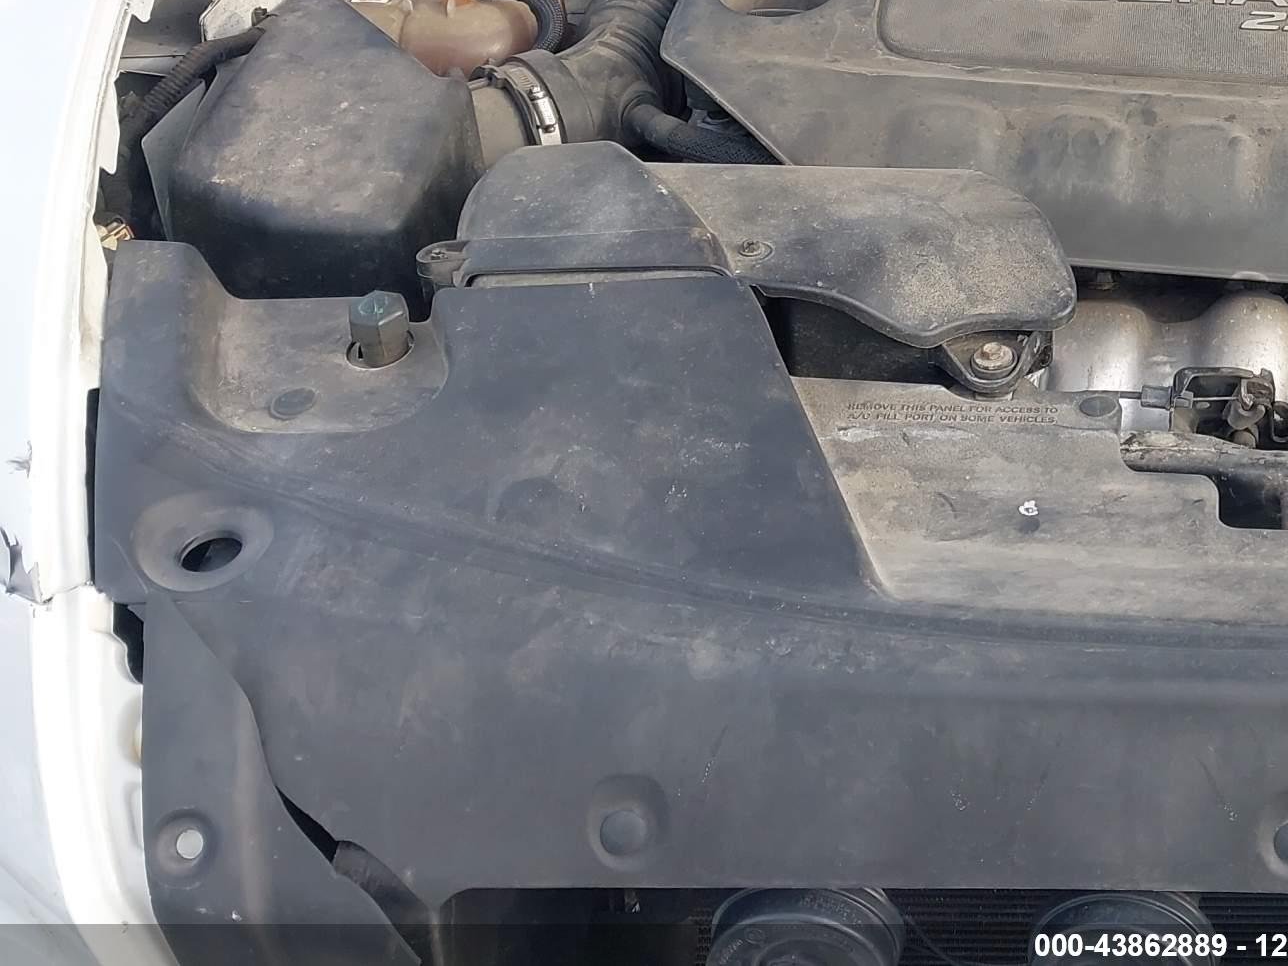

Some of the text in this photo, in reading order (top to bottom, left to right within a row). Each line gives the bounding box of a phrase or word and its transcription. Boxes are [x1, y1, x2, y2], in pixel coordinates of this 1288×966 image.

[847, 403, 897, 411] REMOVE
[901, 404, 926, 412] THIS
[929, 404, 966, 413] PANEL
[969, 405, 993, 413] FOR
[995, 406, 1041, 414] ACCESS
[876, 412, 899, 421] FILL
[904, 413, 935, 422] PORT
[939, 414, 958, 422] ON
[961, 414, 995, 423] SOME
